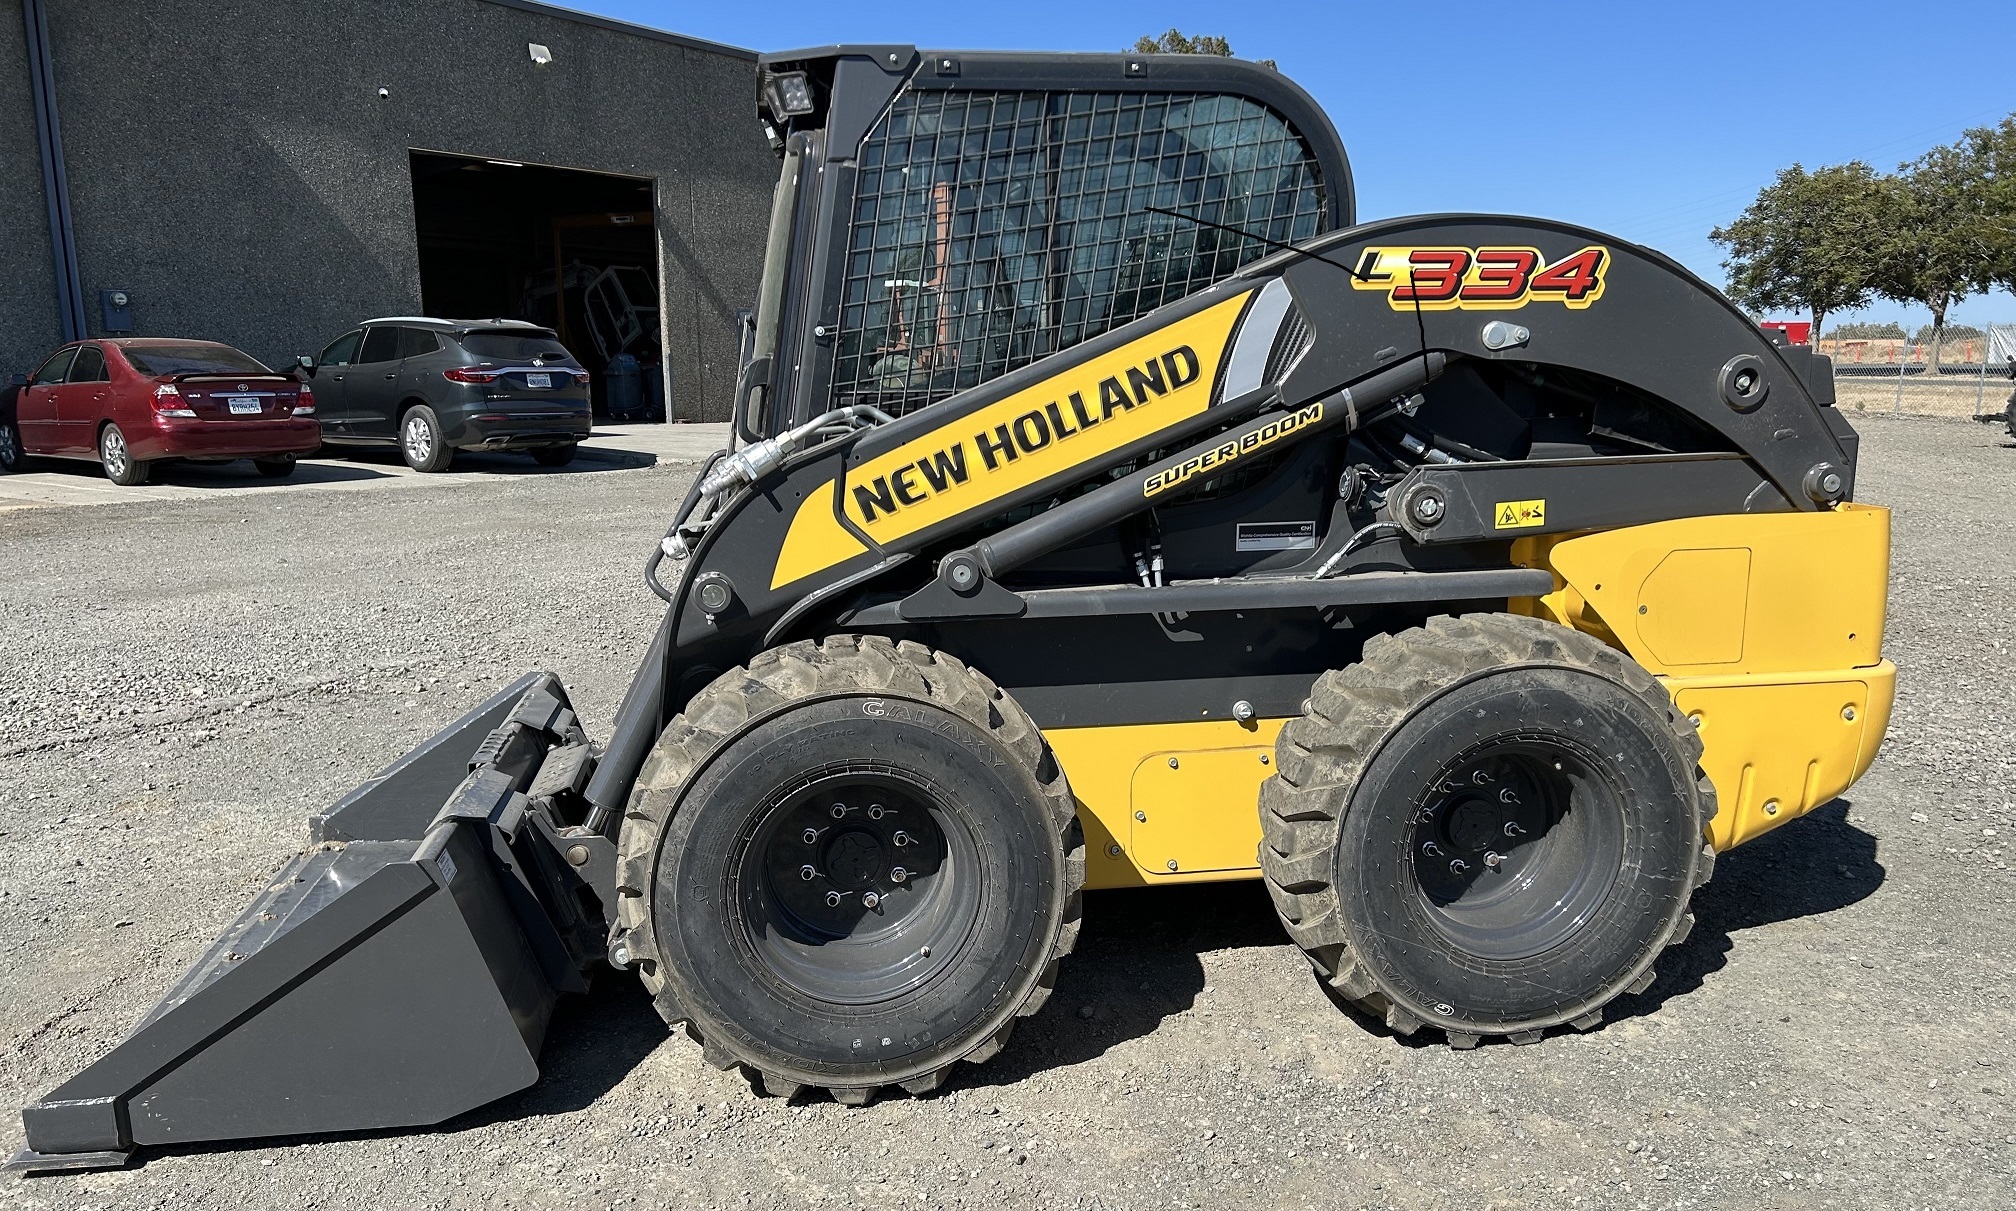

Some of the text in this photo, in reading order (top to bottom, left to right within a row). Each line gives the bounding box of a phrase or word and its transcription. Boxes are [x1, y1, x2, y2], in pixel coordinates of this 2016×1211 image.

[1355, 249, 1606, 302] L334
[852, 345, 1201, 523] NEW HOLLAND
[1144, 404, 1323, 495] SUPER BOOM
[862, 697, 1007, 769] GALAXY
